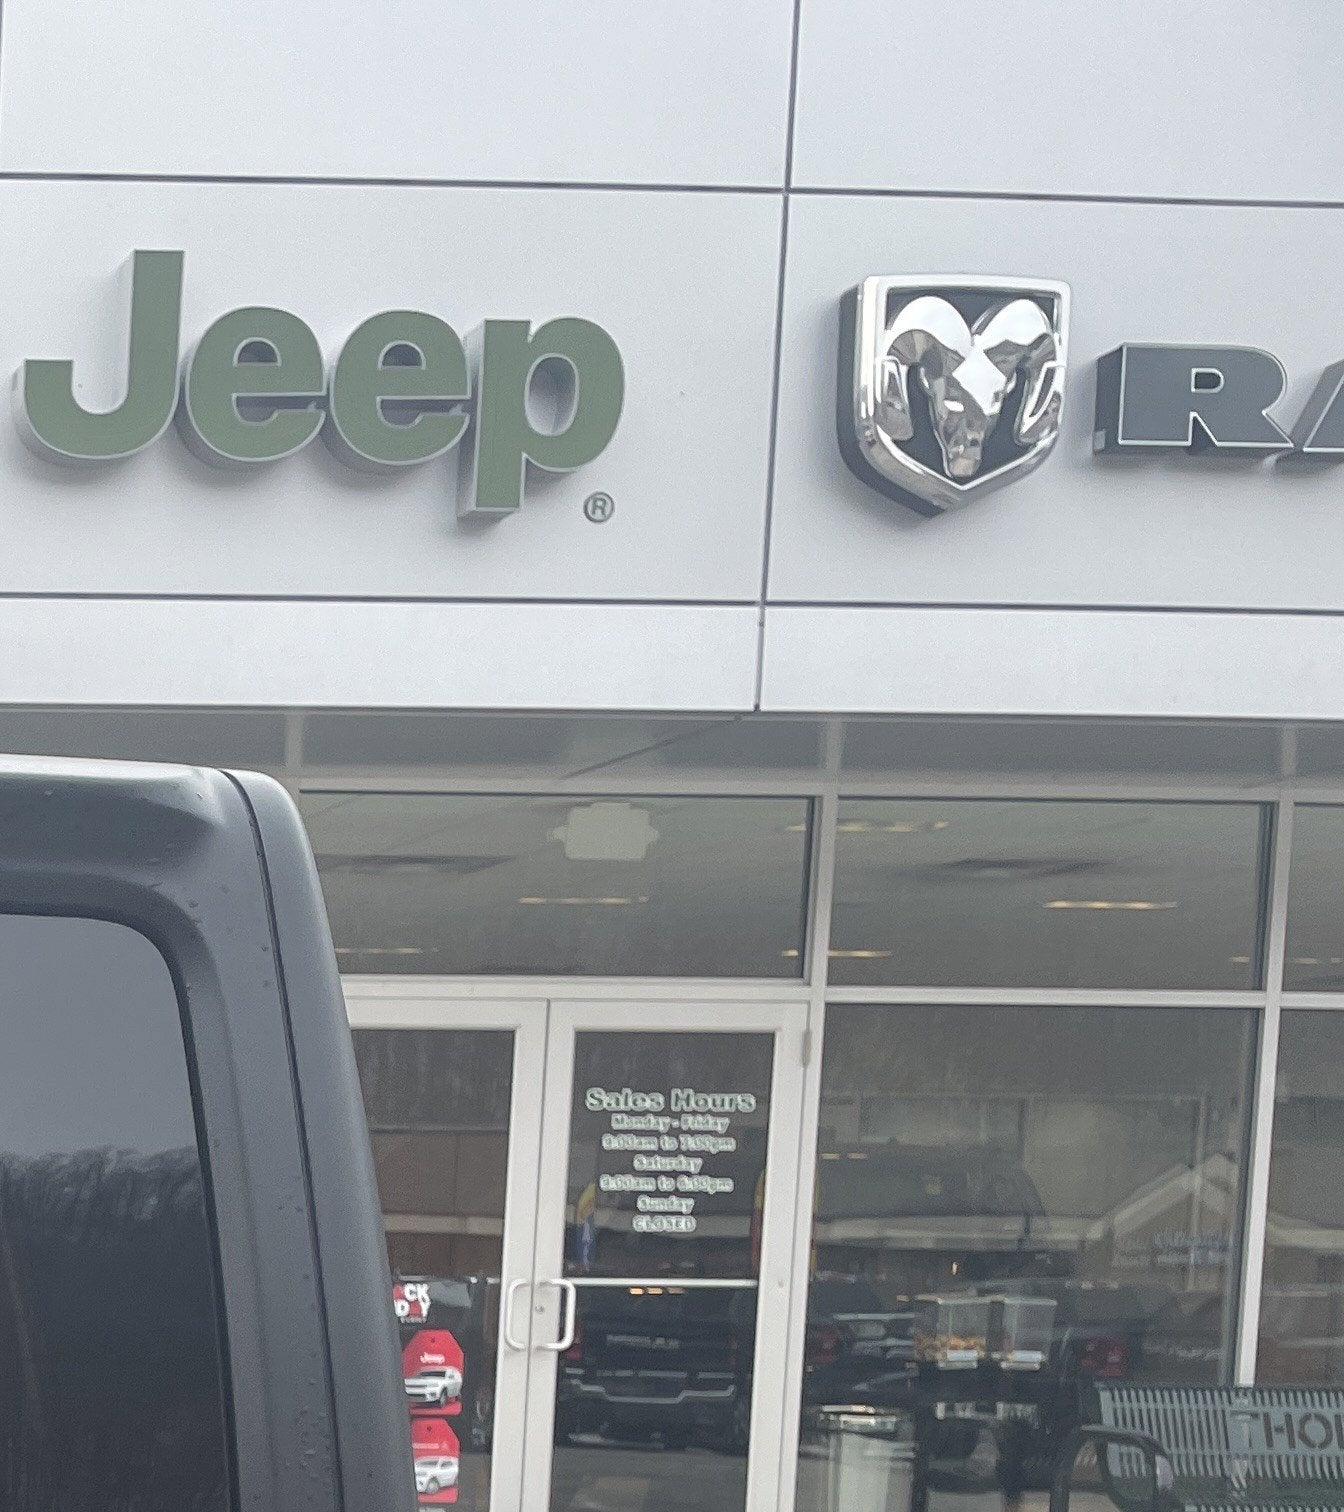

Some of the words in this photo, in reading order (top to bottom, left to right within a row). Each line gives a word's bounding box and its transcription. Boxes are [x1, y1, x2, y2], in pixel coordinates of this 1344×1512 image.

[16, 249, 626, 520] Jeep
[585, 1087, 664, 1112] Sales
[670, 1088, 756, 1113] Hours
[611, 1113, 670, 1133] Monday
[680, 1114, 730, 1134] Friday
[633, 1154, 703, 1174] Saturday
[637, 1195, 695, 1214] Sunday
[632, 1214, 697, 1232] CLOSED
